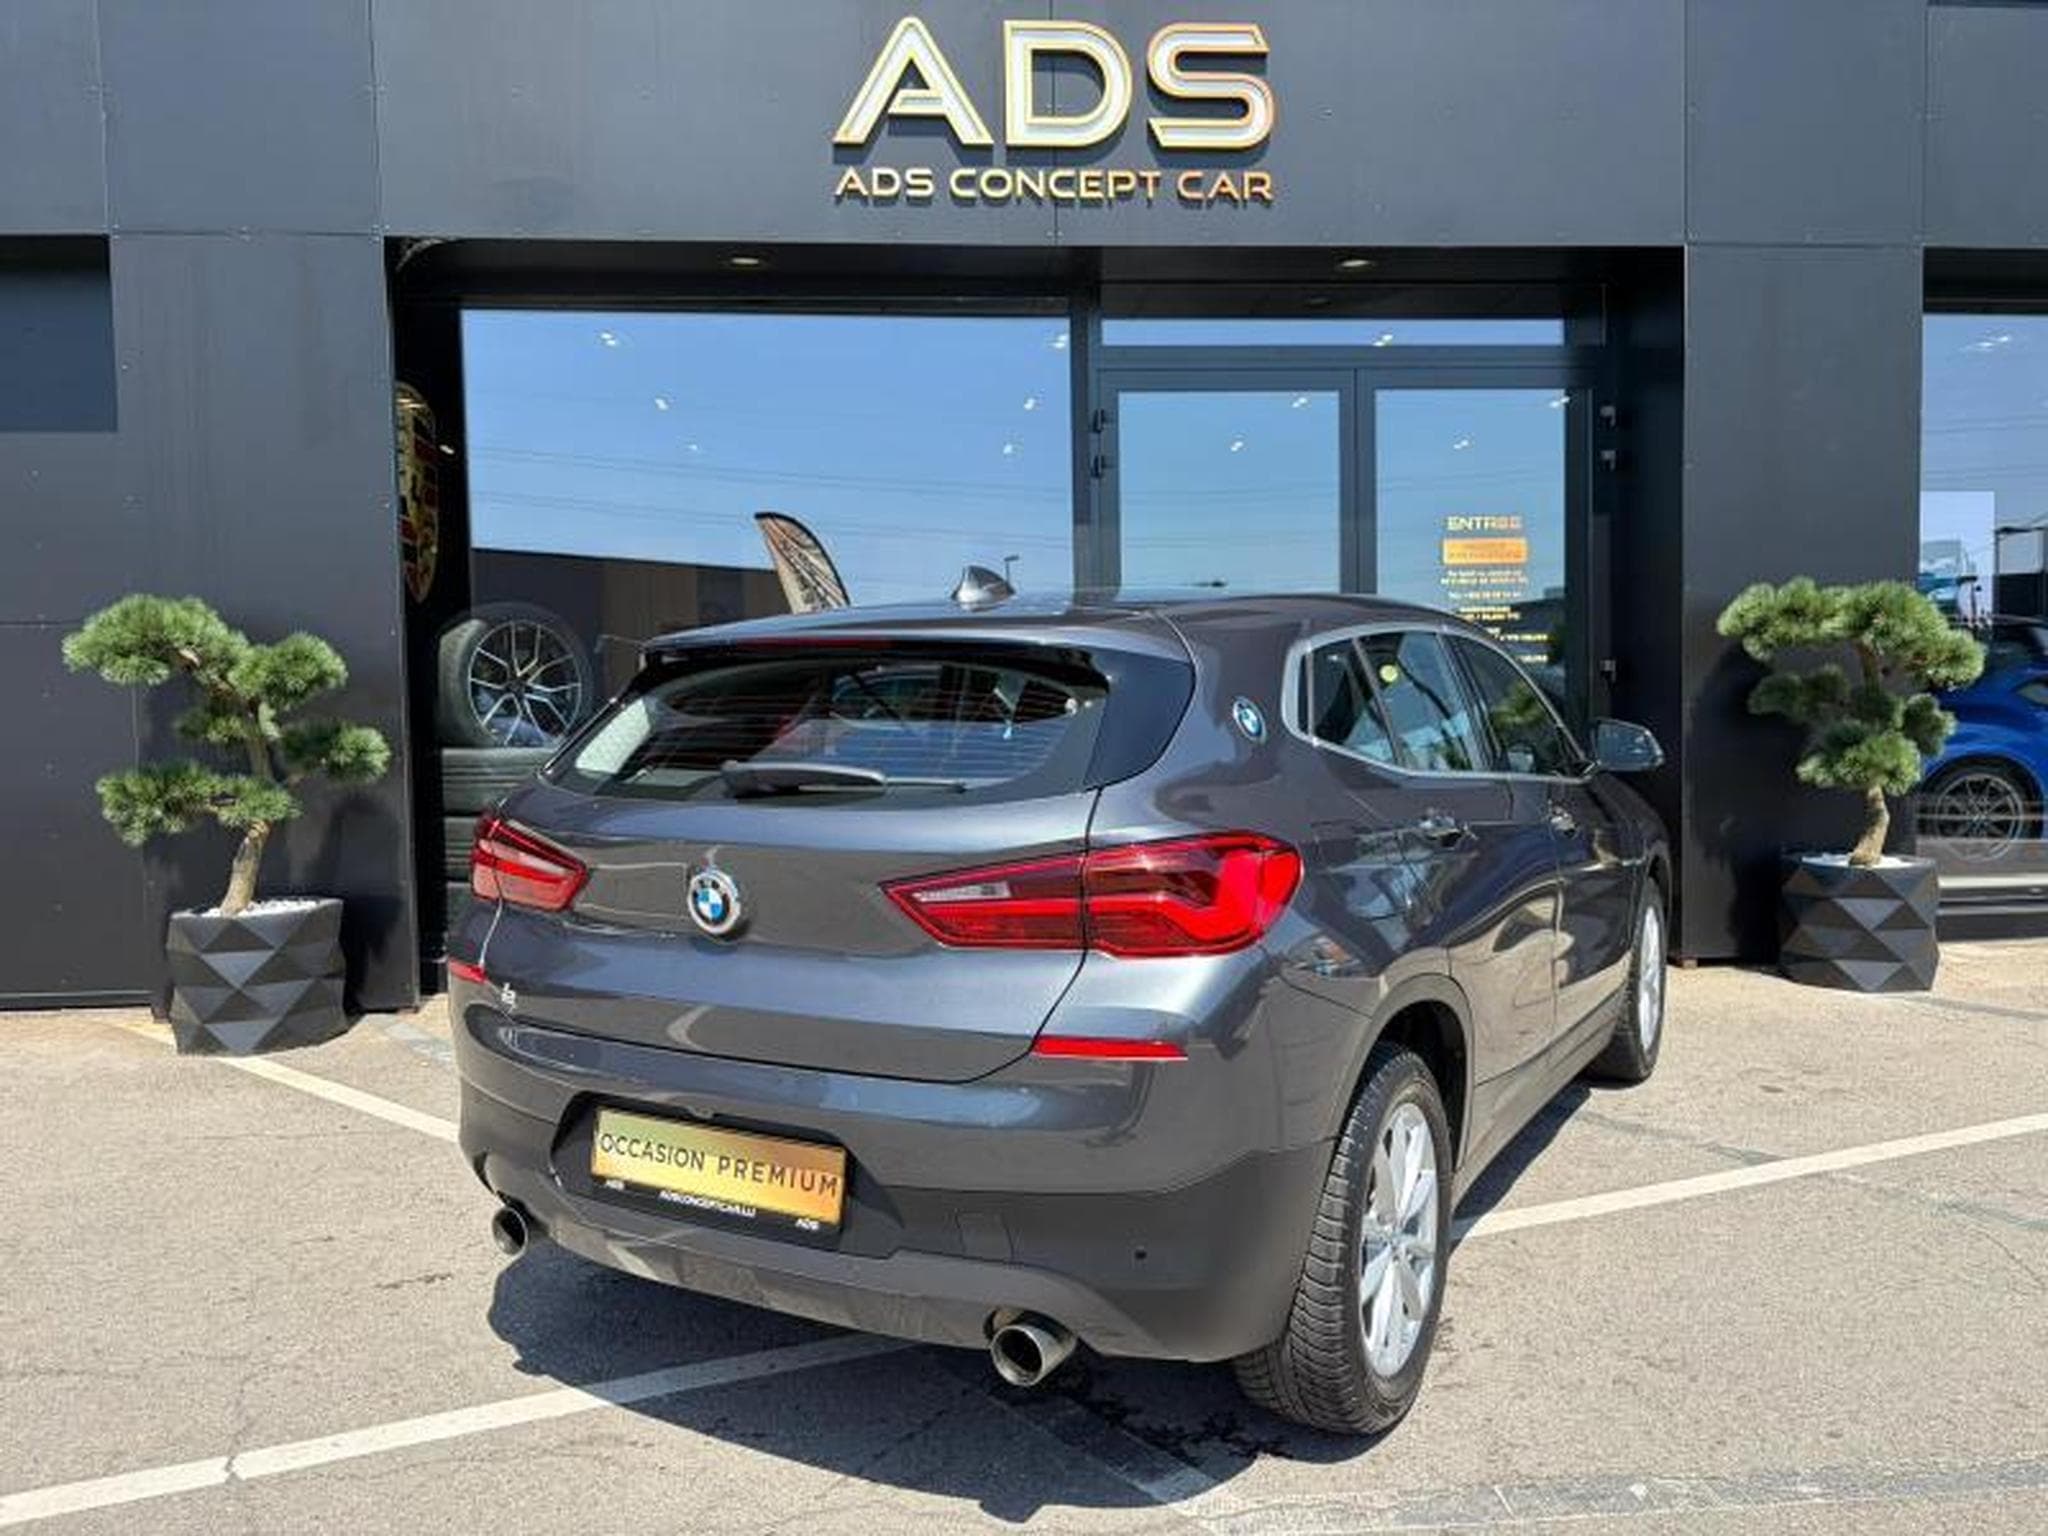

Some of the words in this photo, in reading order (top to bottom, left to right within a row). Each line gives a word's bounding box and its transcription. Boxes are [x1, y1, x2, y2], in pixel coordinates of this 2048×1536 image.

[832, 15, 1275, 149] ADS
[835, 167, 934, 198] ADS
[949, 169, 1161, 200] CONCEPT
[1177, 171, 1273, 200] CAR
[600, 1132, 705, 1172] OCCASION
[717, 1155, 838, 1198] PREMIUM
